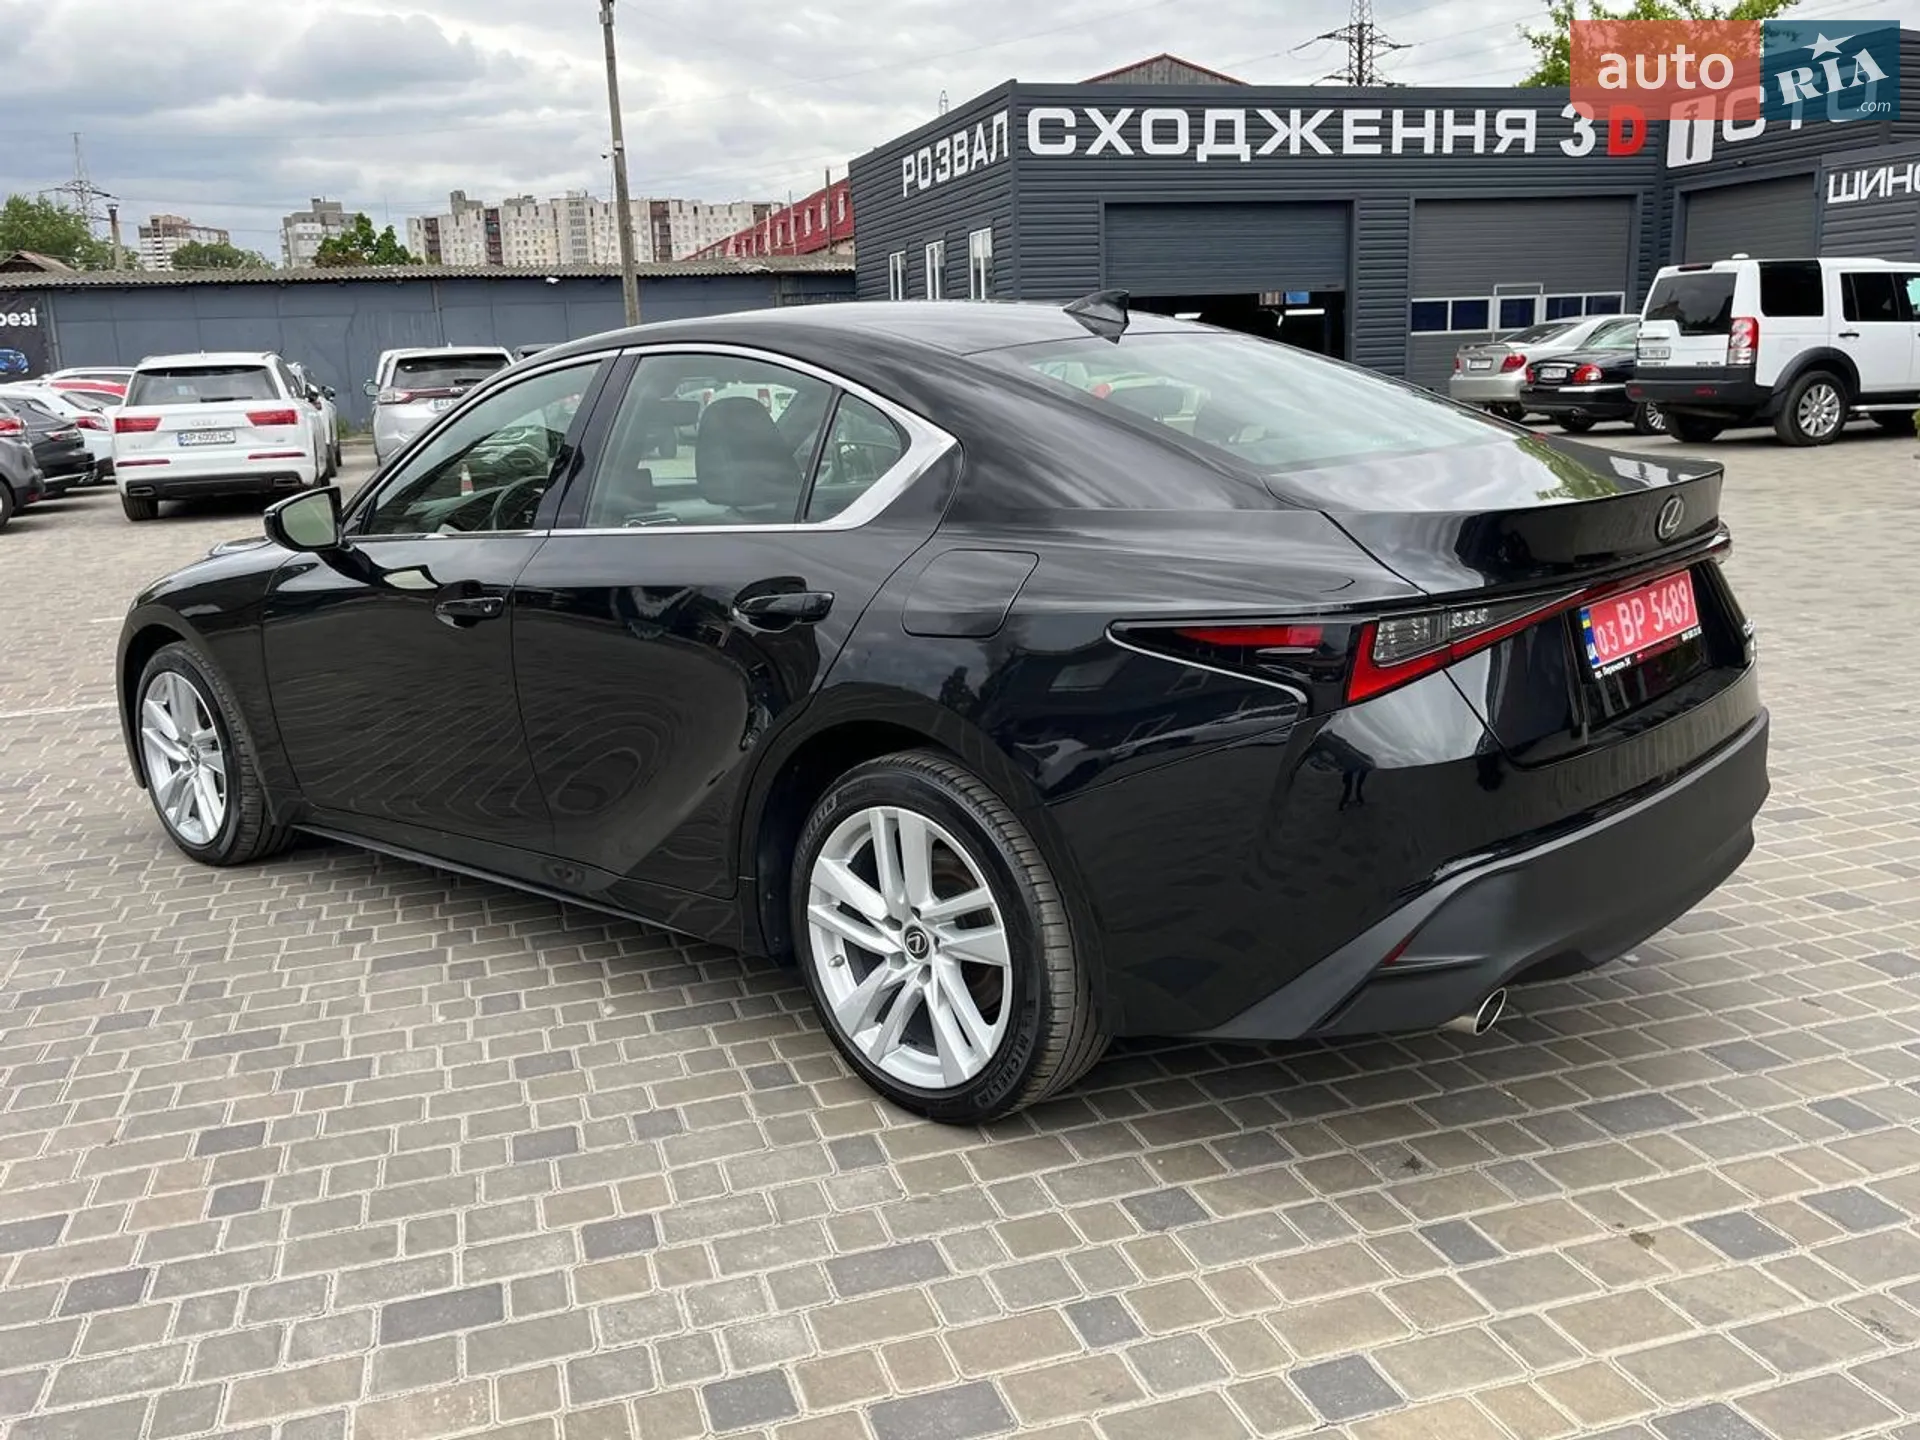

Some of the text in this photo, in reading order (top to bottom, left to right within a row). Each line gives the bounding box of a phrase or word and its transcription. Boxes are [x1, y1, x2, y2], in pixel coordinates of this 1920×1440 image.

[902, 109, 1009, 198] РОЗВАЛ
[1027, 101, 1648, 163] СХОДЖЕННЯ 3D
[1827, 163, 1920, 204] ШИН
[1648, 579, 1690, 633] 5489
